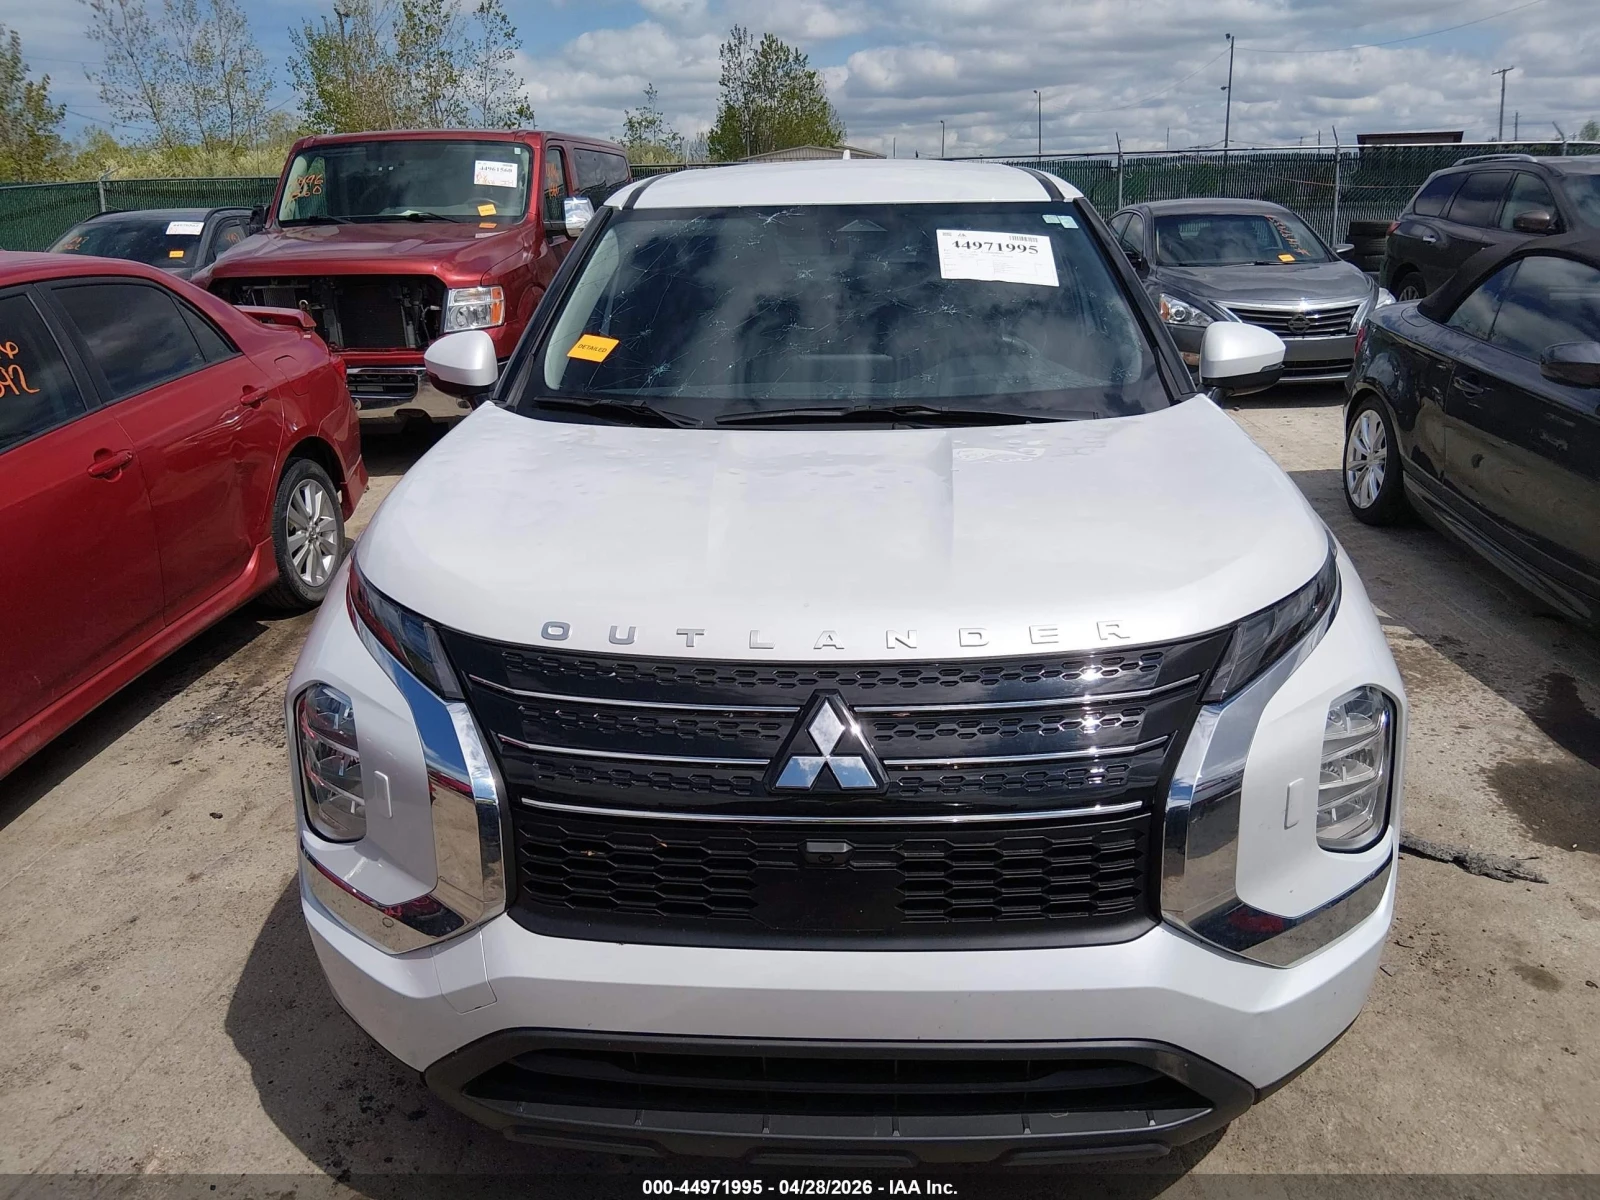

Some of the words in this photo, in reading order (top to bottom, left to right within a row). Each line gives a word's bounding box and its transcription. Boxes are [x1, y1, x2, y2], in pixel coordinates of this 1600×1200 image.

[952, 240, 1039, 254] 44971995
[577, 343, 608, 353] DETAILED
[540, 620, 1131, 650] OUTLANDER
